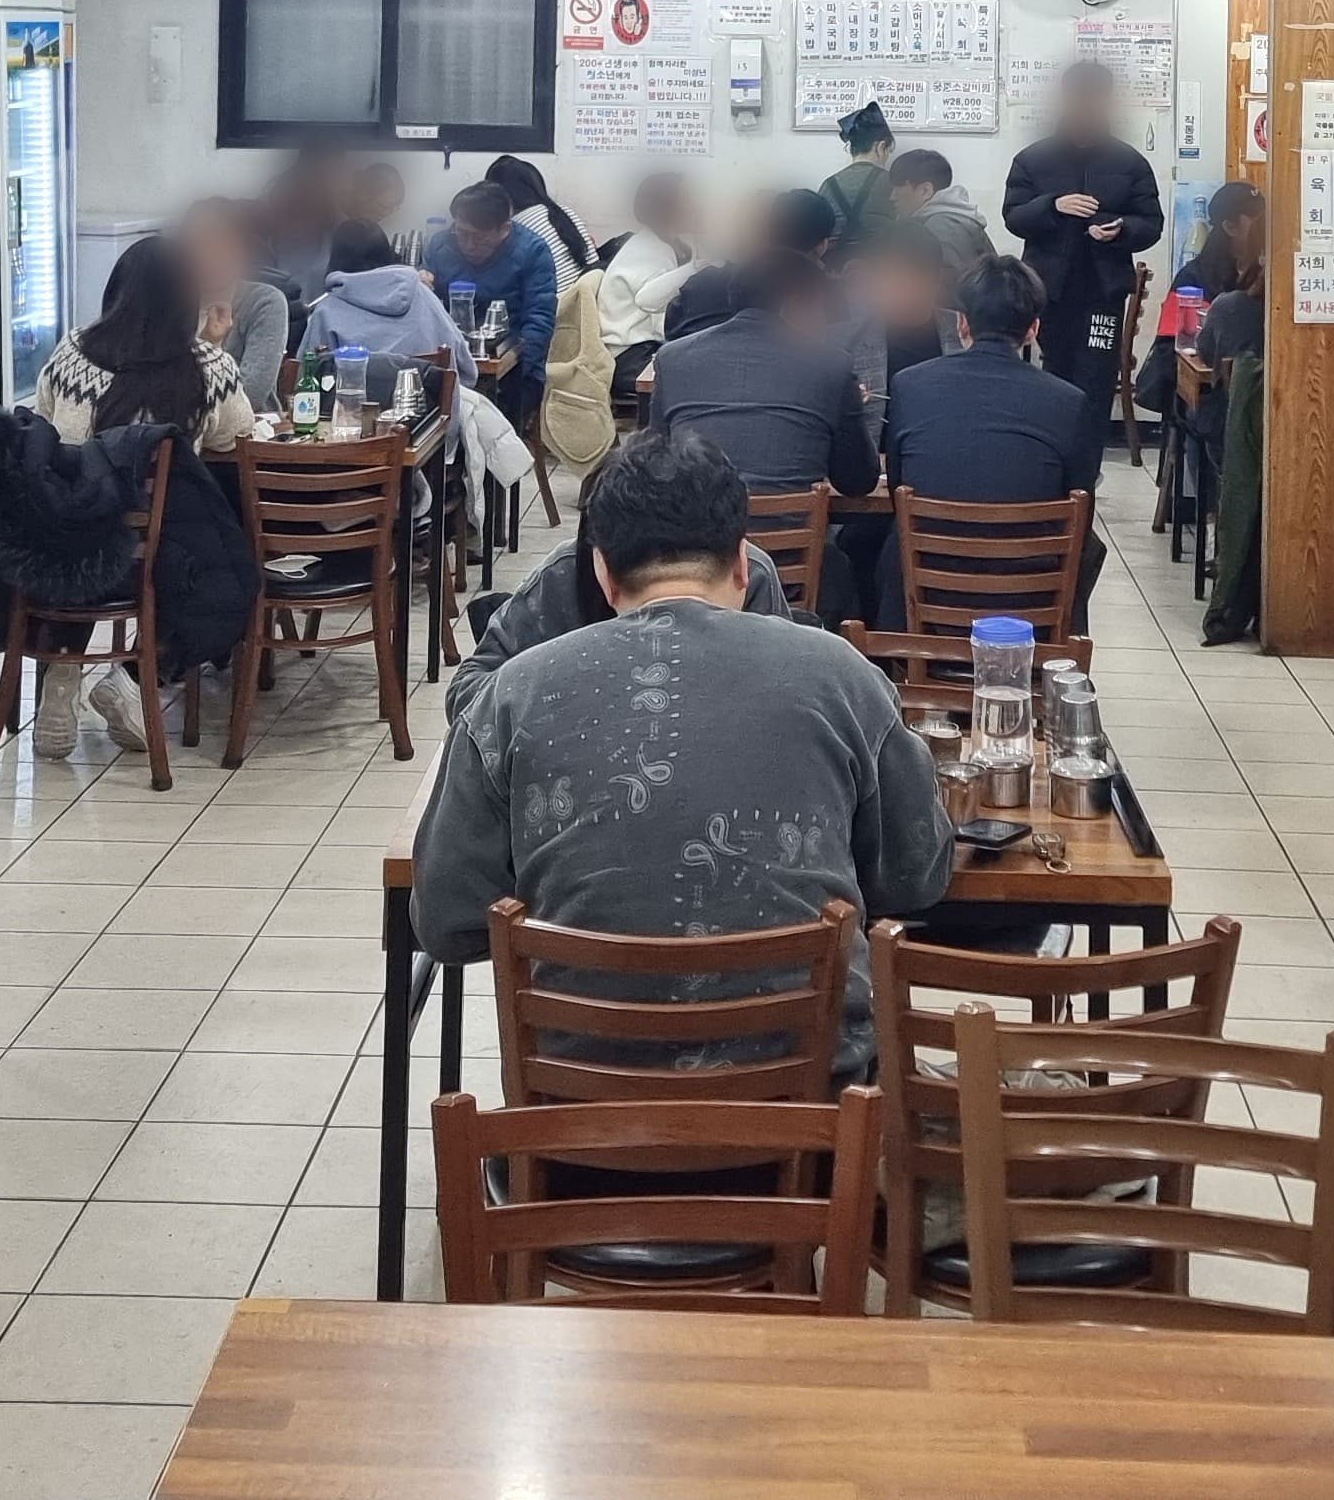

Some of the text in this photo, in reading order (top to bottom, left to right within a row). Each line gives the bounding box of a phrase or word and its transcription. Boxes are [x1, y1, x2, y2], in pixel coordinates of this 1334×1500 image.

[1298, 256, 1325, 271] 저희
[1298, 301, 1312, 315] 재
[1091, 313, 1117, 327] NIKE
[1090, 325, 1115, 338] NIKE
[1087, 336, 1113, 350] NIKE
